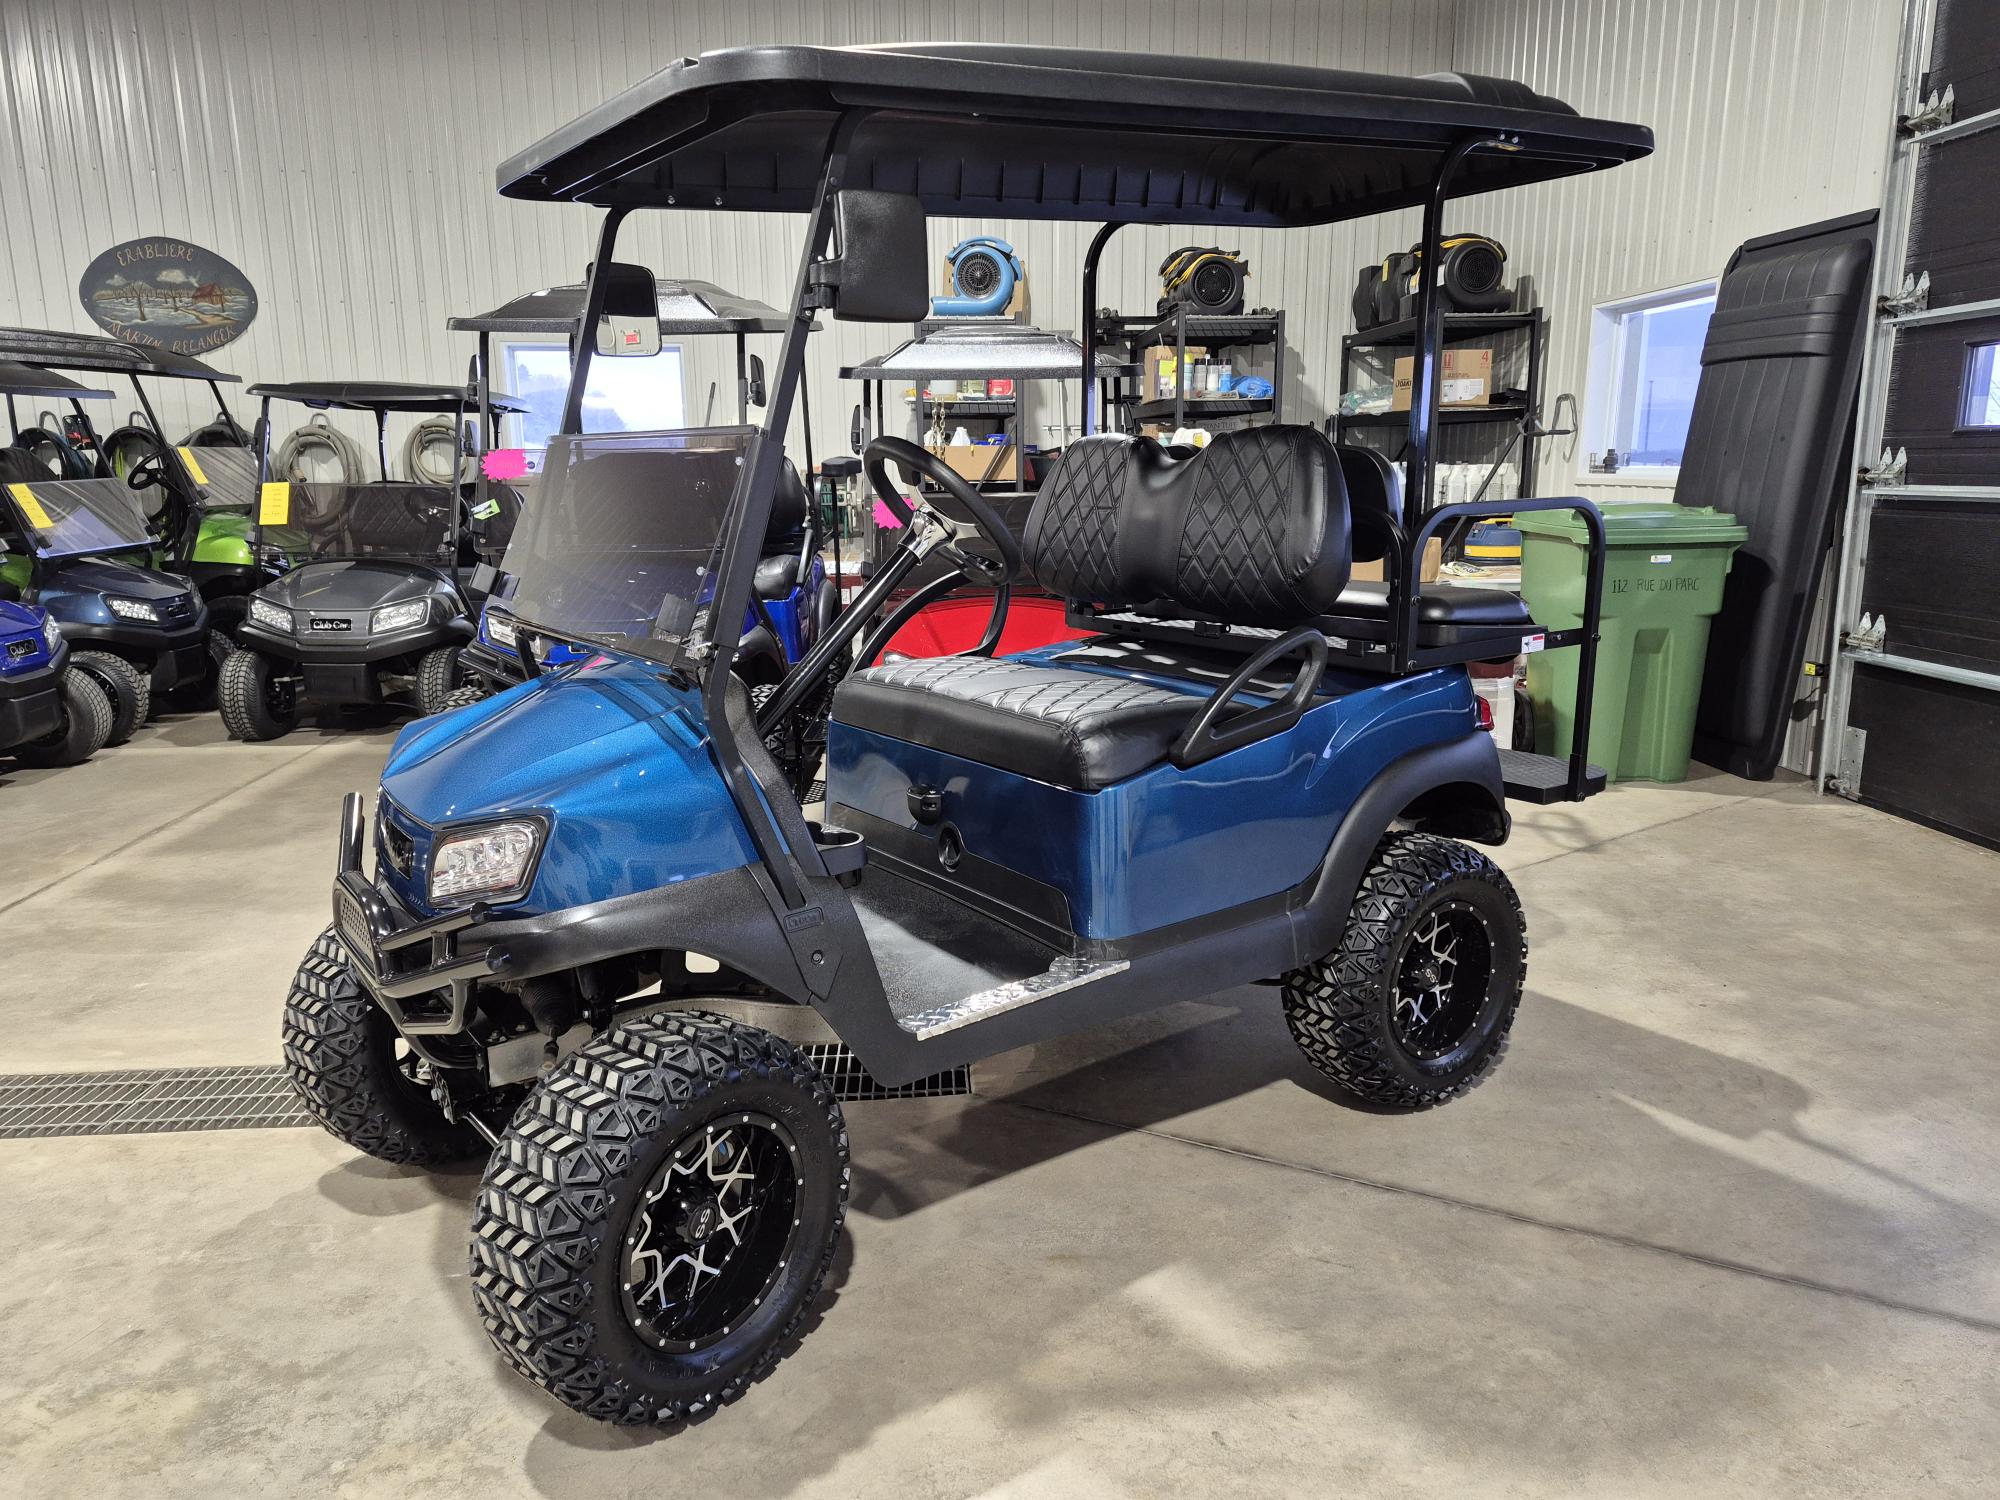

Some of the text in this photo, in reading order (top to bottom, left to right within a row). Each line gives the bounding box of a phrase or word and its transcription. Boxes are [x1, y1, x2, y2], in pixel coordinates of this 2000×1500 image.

[172, 325, 237, 352] BELANGER
[1481, 350, 1490, 363] 4
[1611, 577, 1700, 594] 112 RUE DU PARC
[313, 620, 332, 630] Club
[695, 1208, 711, 1239] SS
